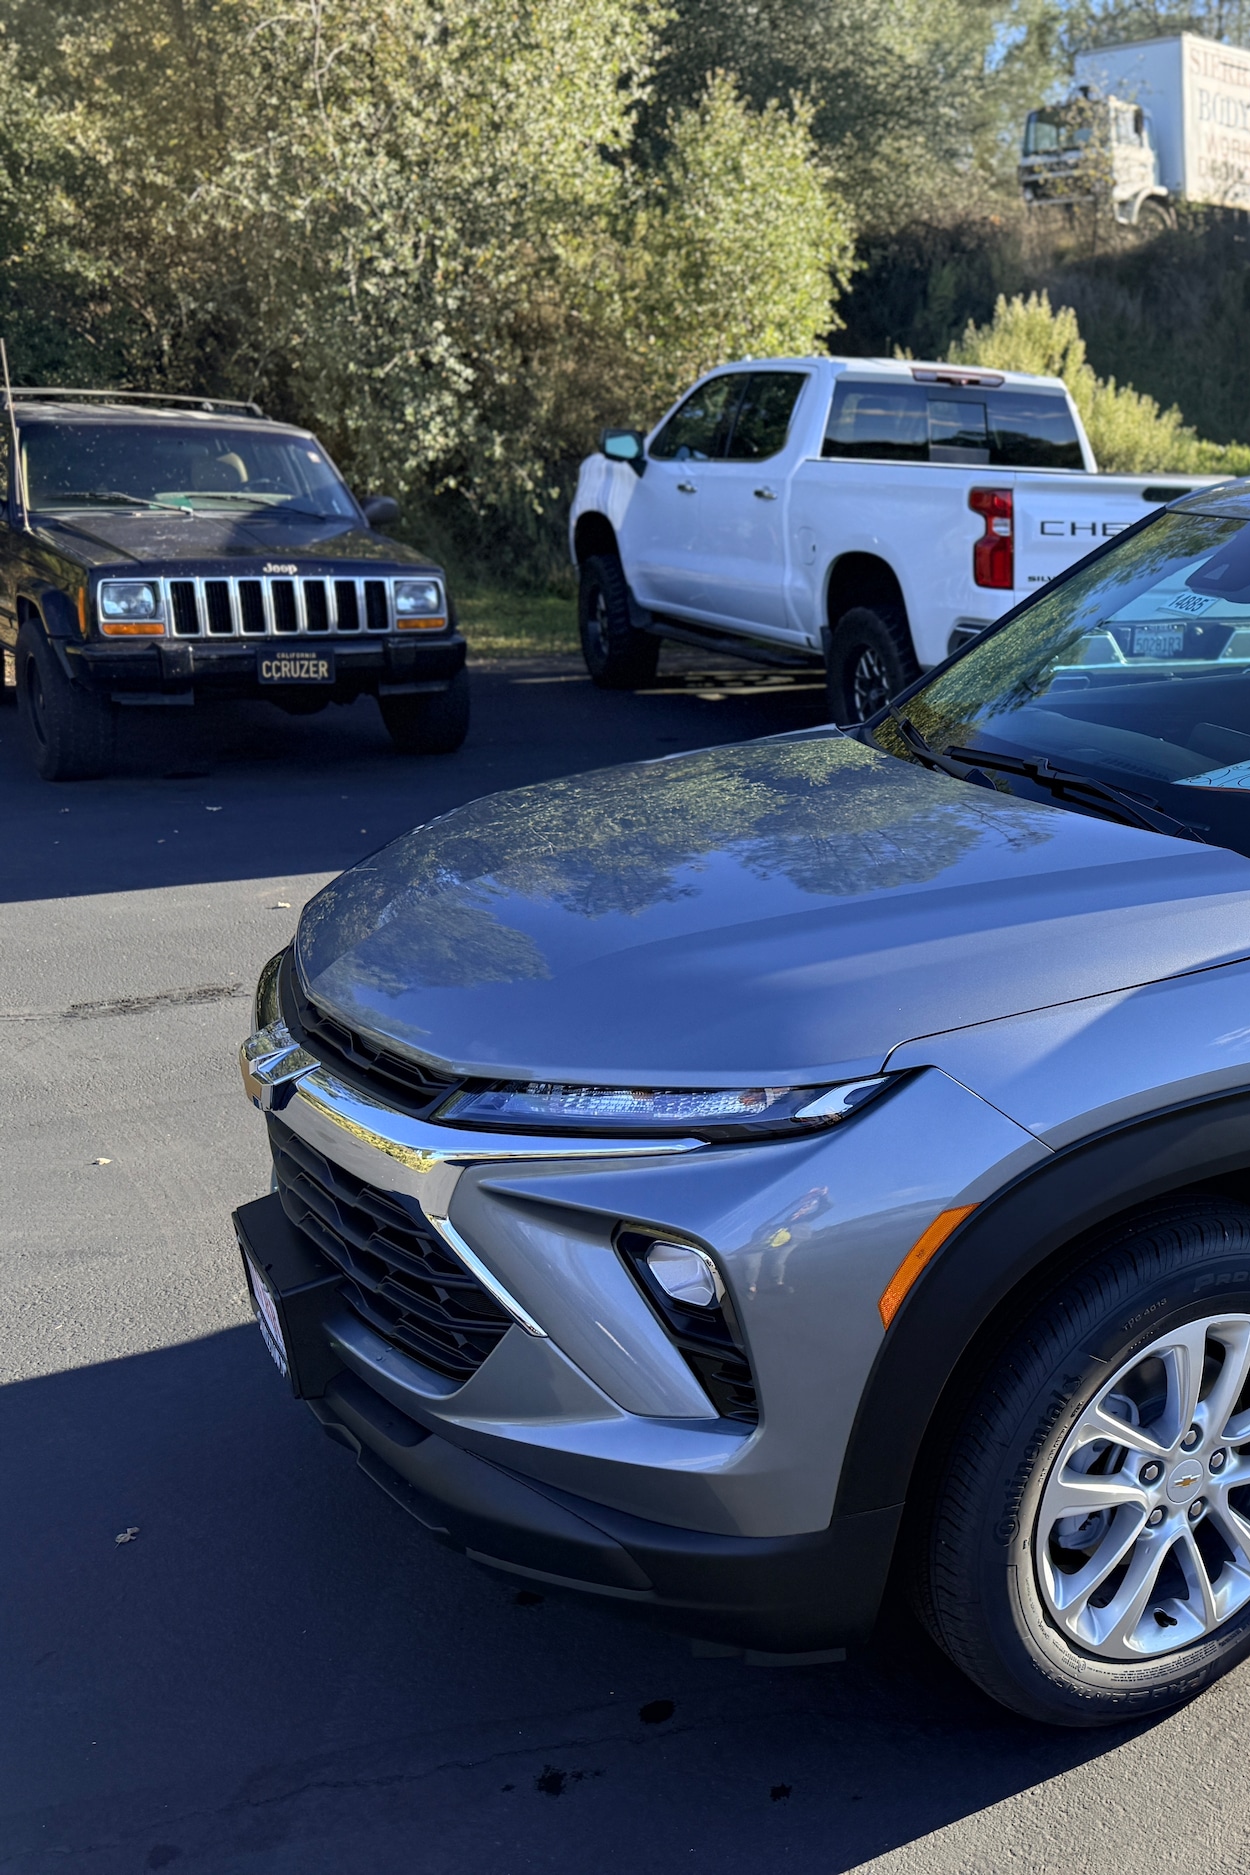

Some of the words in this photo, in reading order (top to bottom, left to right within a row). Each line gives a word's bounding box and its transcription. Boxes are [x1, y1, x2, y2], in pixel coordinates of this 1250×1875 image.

[263, 563, 298, 575] Jeep
[276, 652, 317, 660] CALIFORNIA
[262, 661, 328, 678] CCRUZER
